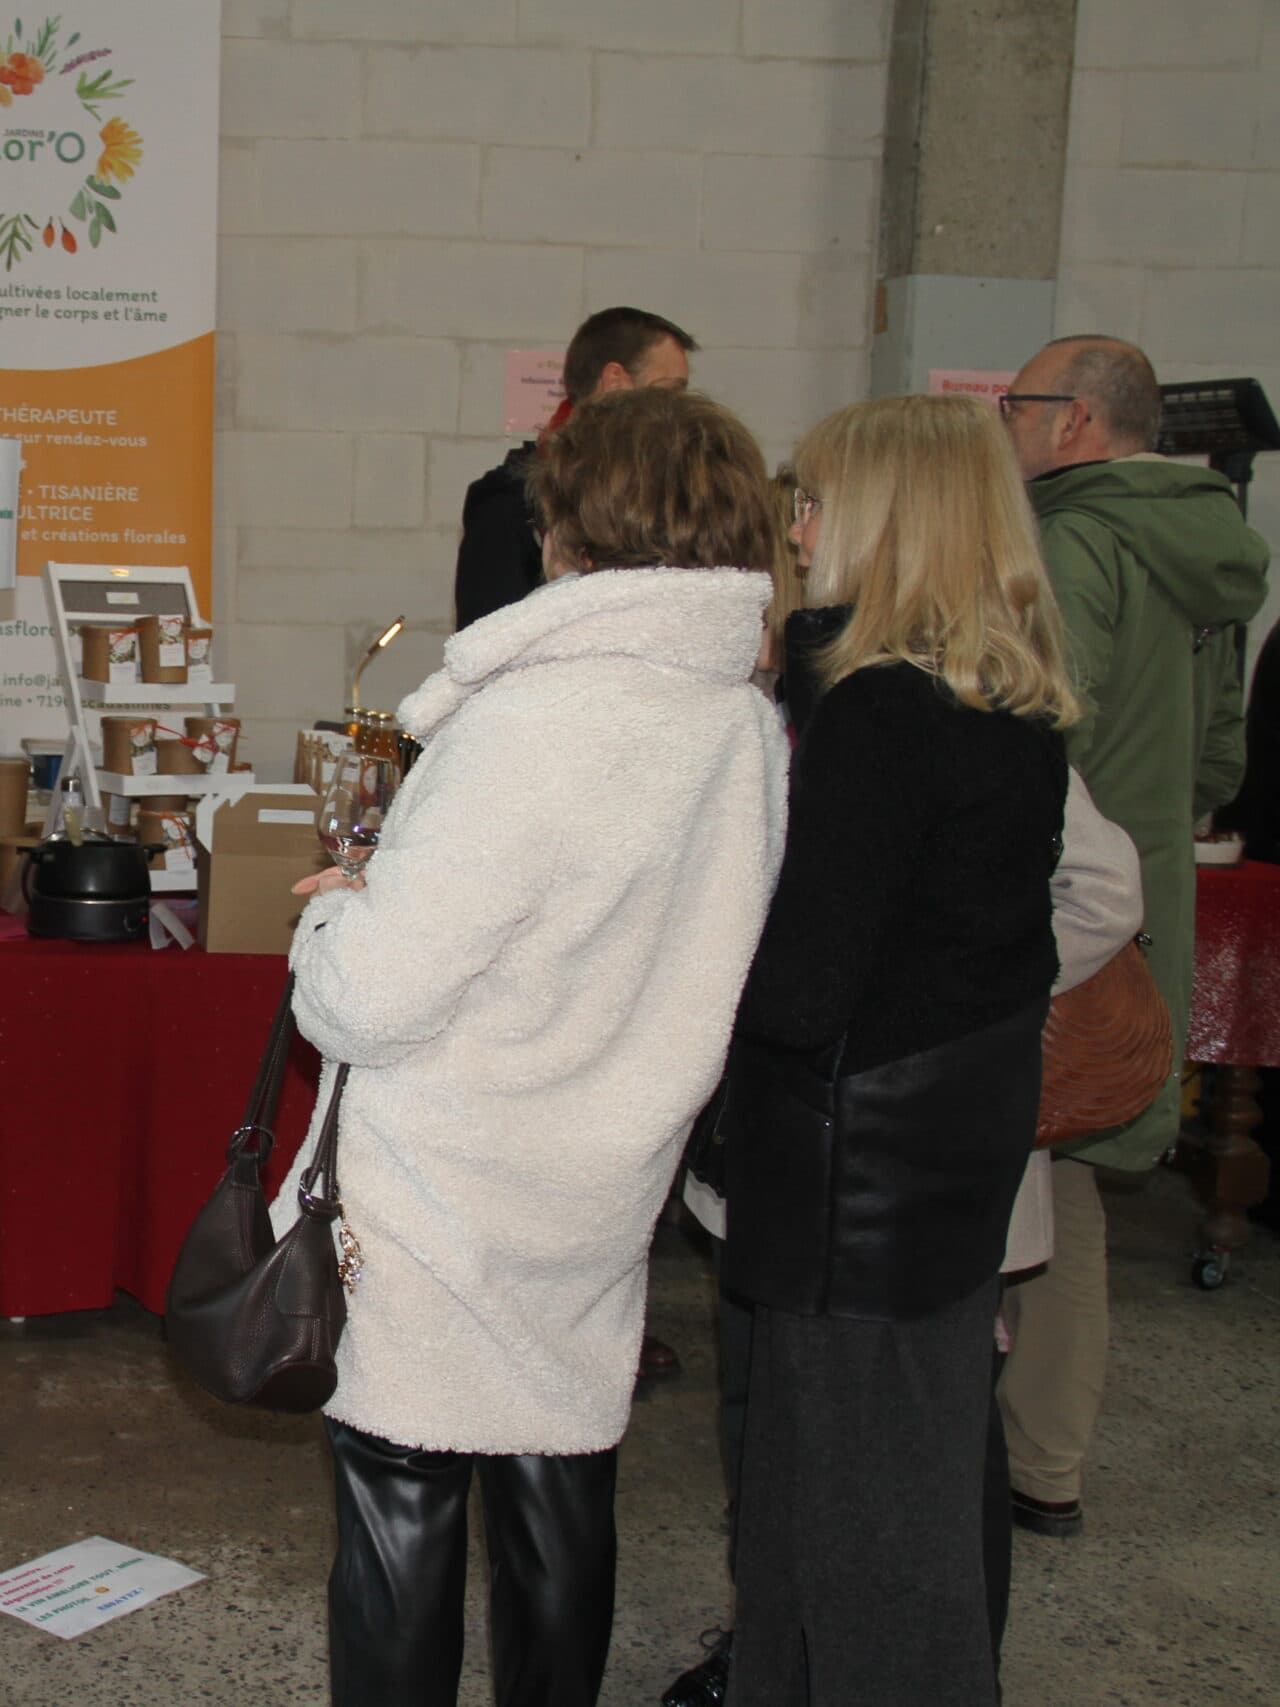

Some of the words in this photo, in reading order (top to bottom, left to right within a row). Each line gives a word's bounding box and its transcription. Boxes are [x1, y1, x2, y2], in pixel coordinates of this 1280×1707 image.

[4, 129, 44, 137] JARDINS
[66, 285, 158, 302] localement
[35, 304, 49, 318] le
[54, 308, 98, 323] corps
[103, 308, 119, 321] et
[124, 307, 168, 322] l'âme
[46, 433, 147, 447] rendez-vous
[39, 482, 139, 502] TISANIÈRE
[21, 530, 37, 541] et
[42, 528, 118, 543] créations
[123, 528, 187, 545] florales
